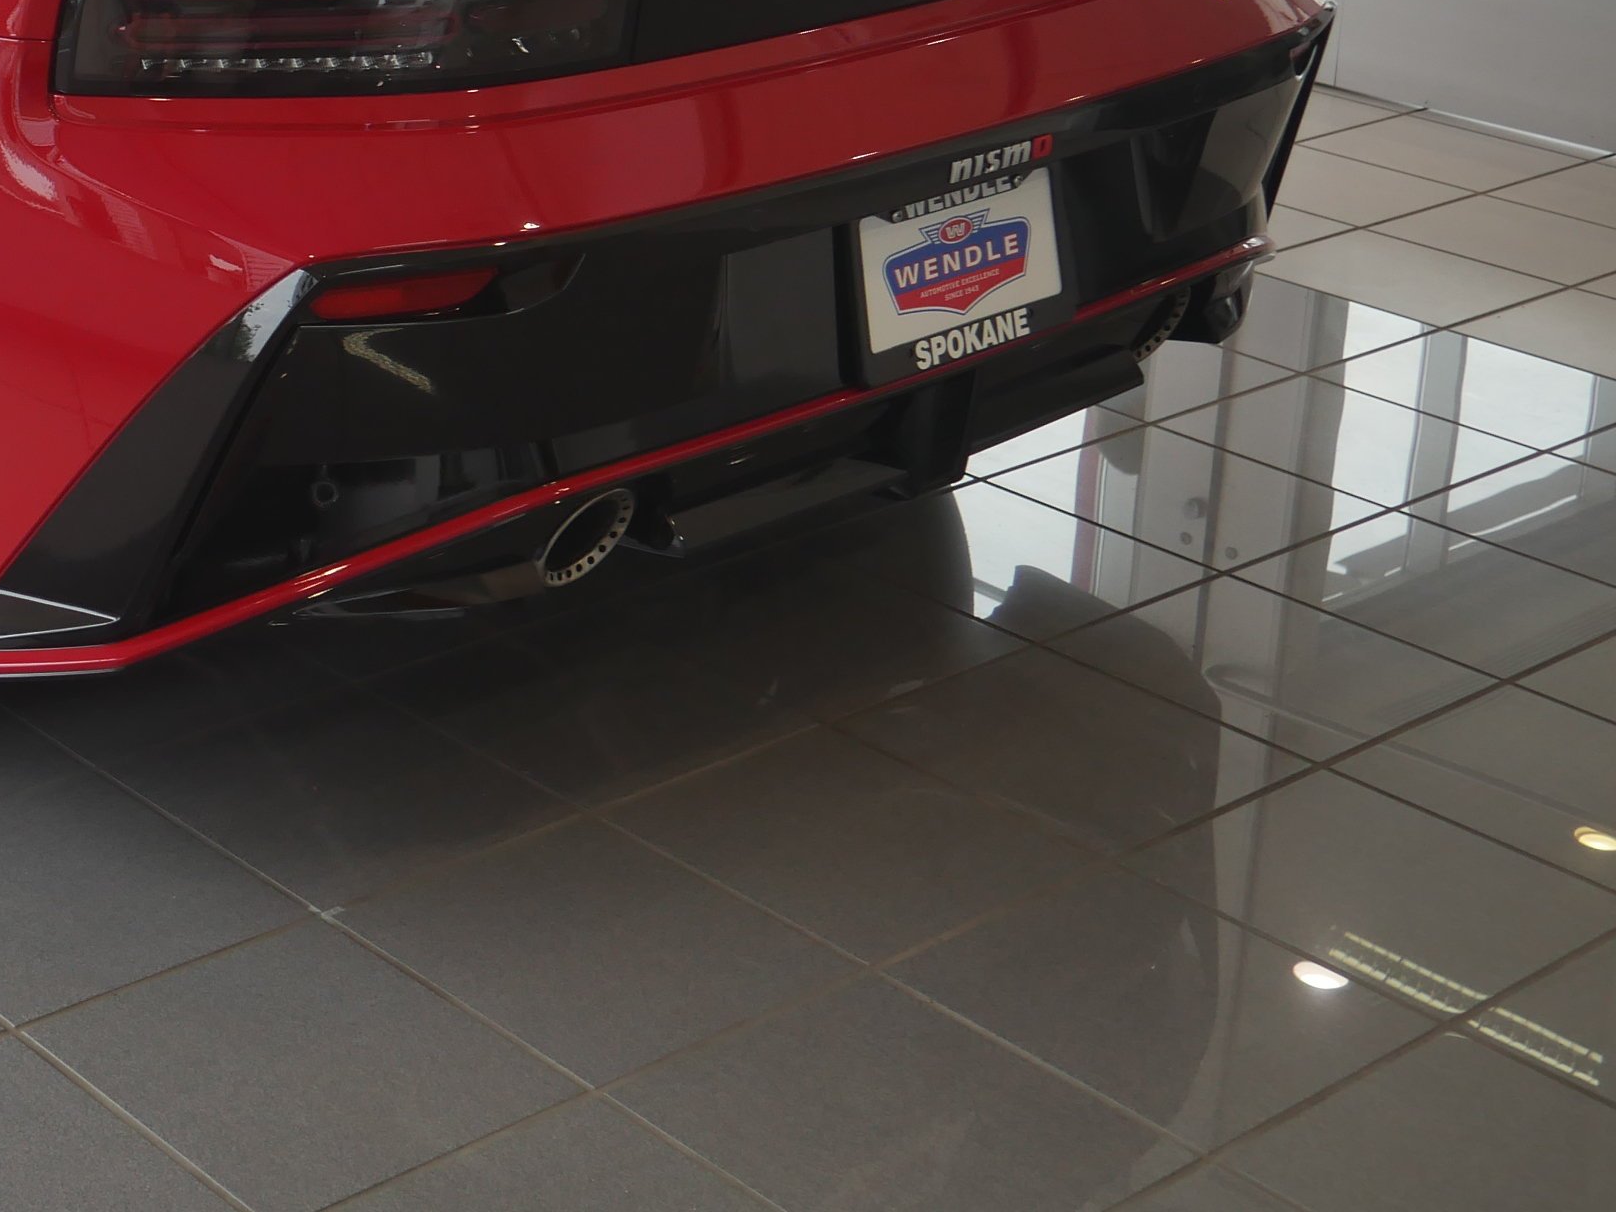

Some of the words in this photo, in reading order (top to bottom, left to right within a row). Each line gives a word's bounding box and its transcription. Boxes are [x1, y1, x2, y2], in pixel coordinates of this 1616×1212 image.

[949, 133, 1054, 185] nismo
[945, 221, 966, 239] W
[894, 233, 1020, 290] WENDLE
[920, 281, 961, 299] AUTOMOTIVE
[960, 268, 1000, 287] EXCELLENCE
[944, 289, 964, 302] SINCE
[915, 306, 1031, 371] SPOKANE
